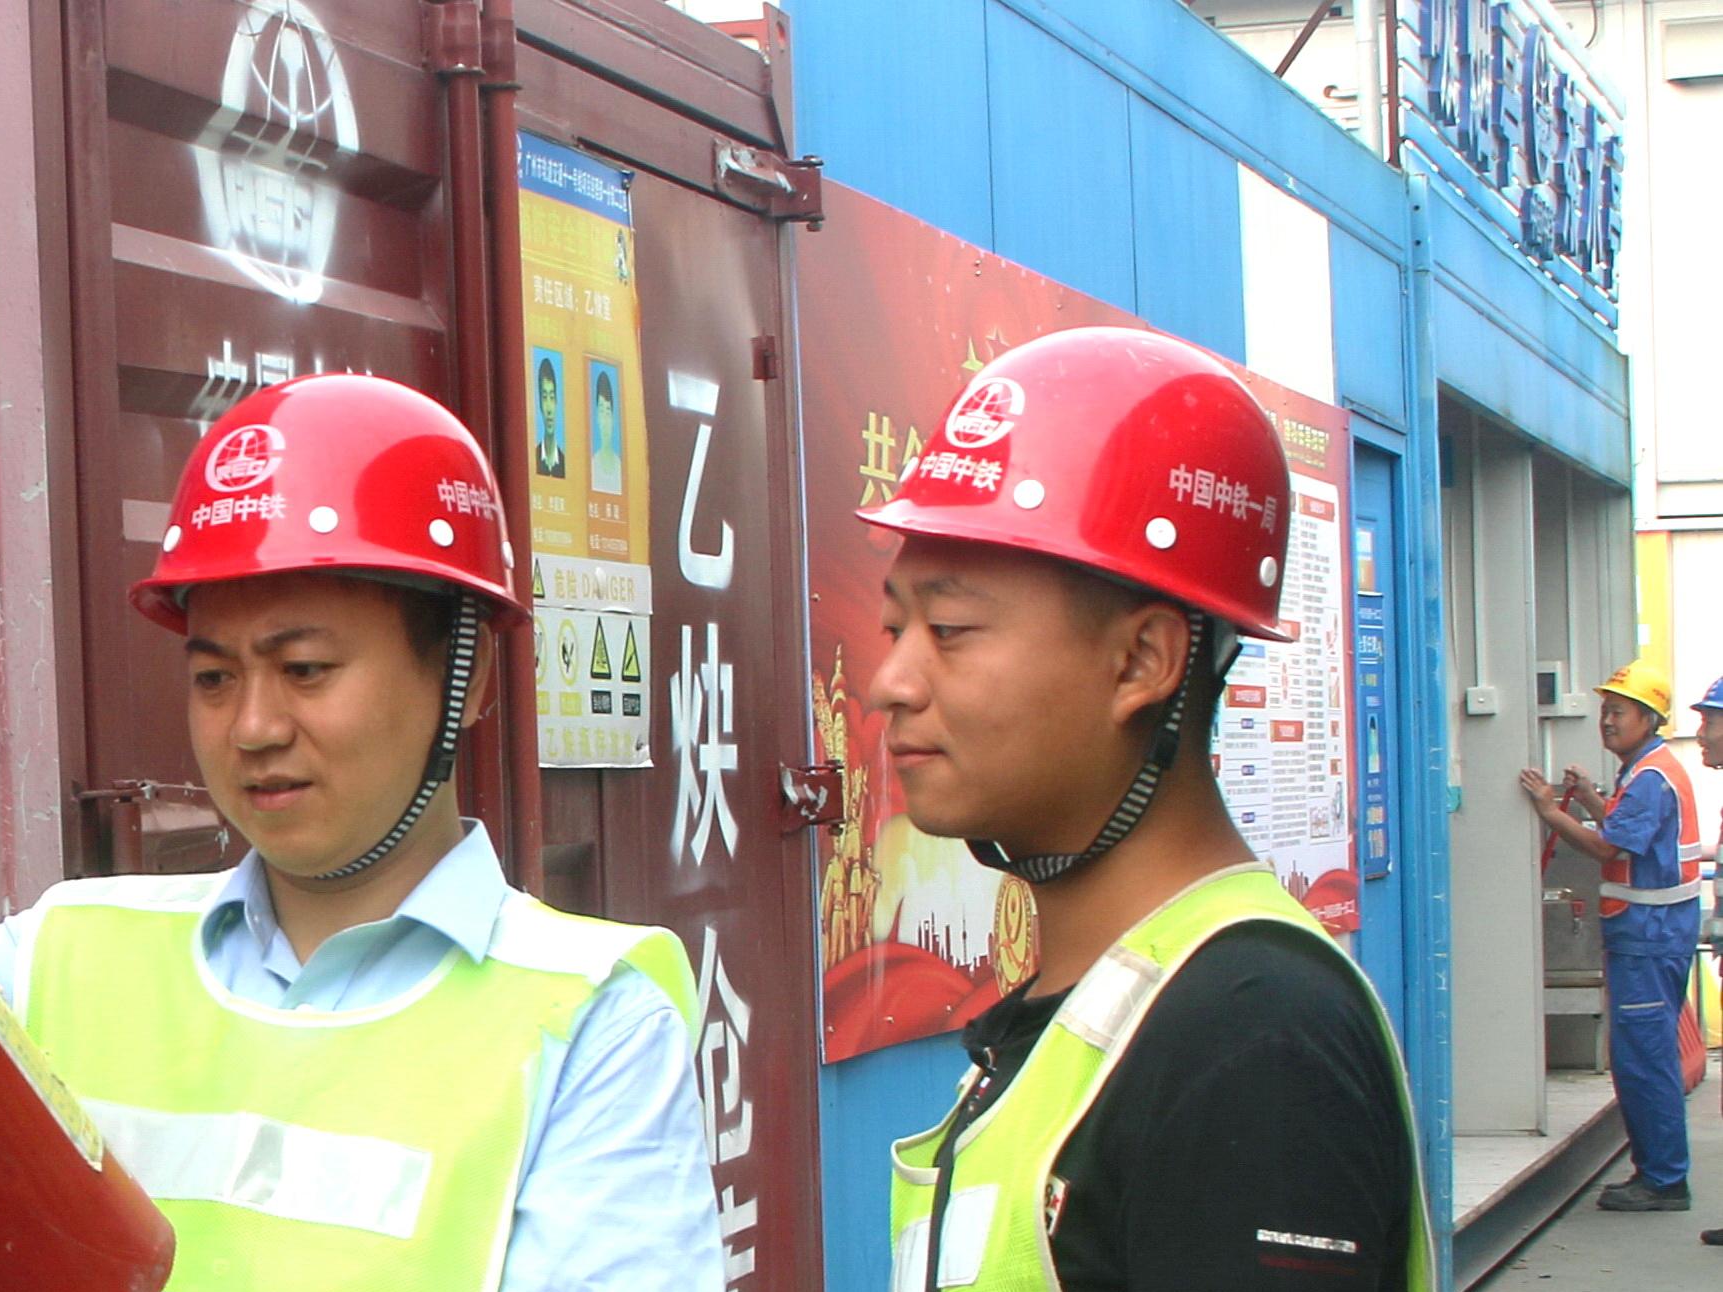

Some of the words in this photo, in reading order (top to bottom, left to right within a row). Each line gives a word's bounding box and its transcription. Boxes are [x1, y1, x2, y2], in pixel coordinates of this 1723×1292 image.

[920, 451, 1004, 492] 中国中铁
[192, 493, 288, 530] 中国中铁
[1169, 463, 1277, 535] 中国中铁一局
